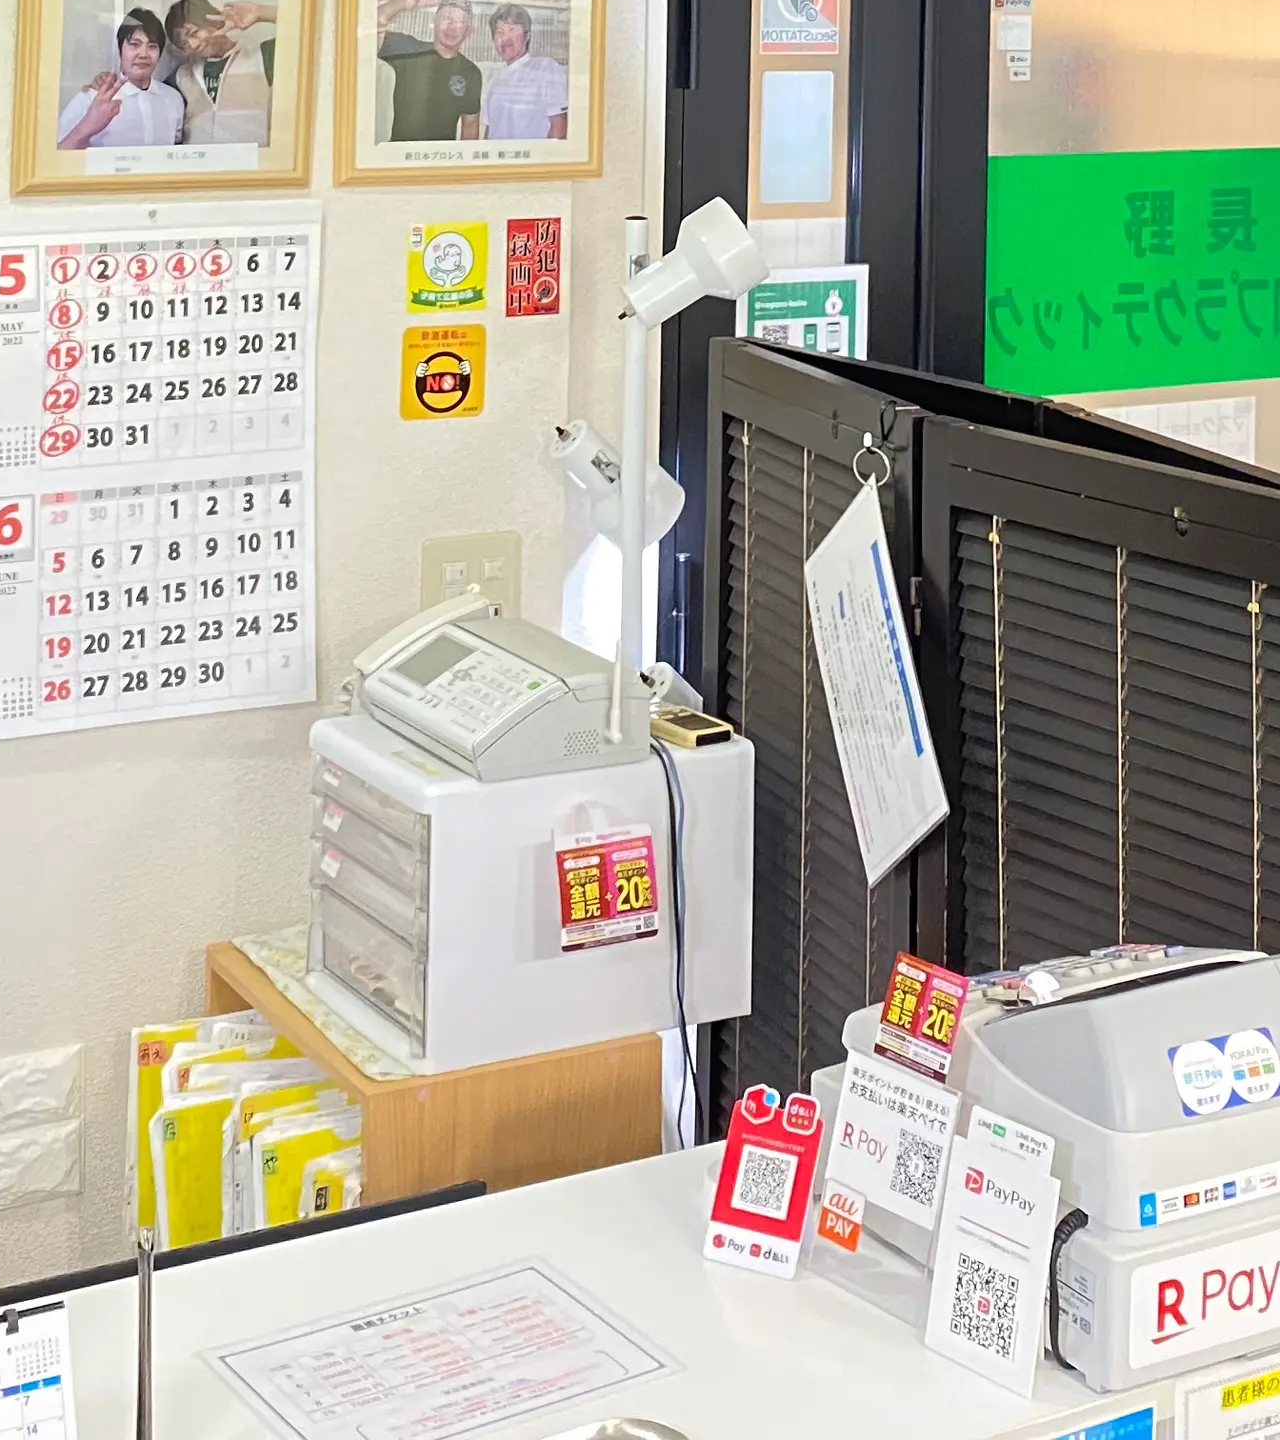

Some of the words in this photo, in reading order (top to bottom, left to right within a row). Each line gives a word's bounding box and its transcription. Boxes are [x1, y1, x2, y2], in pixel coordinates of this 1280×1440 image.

[405, 151, 463, 160] 新日本プロレス
[535, 221, 558, 273] 防犯
[97, 260, 109, 279] 2
[135, 258, 147, 277] 3
[172, 257, 185, 276] 4
[210, 255, 222, 276] 5
[247, 253, 259, 272] 6
[284, 252, 296, 271] 7
[510, 233, 531, 313] 録画中
[57, 305, 70, 324] 8
[97, 302, 109, 322] 9
[129, 300, 153, 319] 10
[167, 298, 189, 317] 11
[204, 296, 227, 315] 12
[241, 294, 263, 312] 13
[277, 291, 301, 311] 14
[0, 322, 24, 332] MAY
[91, 344, 115, 363] 16
[129, 342, 152, 361] 17
[167, 340, 190, 359] 18
[203, 337, 227, 356] 19
[239, 334, 263, 354] 20
[275, 332, 297, 351] 21
[48, 389, 75, 409] 22
[88, 386, 113, 405] 23
[126, 383, 152, 403] 24
[164, 381, 190, 400] 25
[202, 378, 226, 397] 26
[238, 375, 262, 394] 27
[274, 373, 298, 392] 28
[426, 374, 460, 391] NO!
[47, 432, 75, 451] 29
[87, 428, 113, 447] 30
[126, 425, 149, 445] 31
[171, 500, 179, 518] 1
[206, 496, 218, 515] 2
[244, 493, 254, 512] 3
[279, 489, 291, 508] 4
[53, 552, 65, 572] 5
[92, 549, 105, 568] 6
[130, 545, 142, 565] 7
[169, 541, 181, 561] 8
[206, 538, 218, 557] 9
[238, 533, 260, 553] 10
[274, 530, 296, 549] 11
[46, 595, 71, 616] 12
[86, 590, 109, 611] 13
[124, 586, 149, 607] 14
[162, 583, 186, 602] 15
[200, 579, 224, 599] 16
[237, 575, 260, 595] 17
[274, 571, 298, 590] 18
[46, 638, 71, 659] 19
[84, 633, 109, 654] 20
[122, 629, 146, 650] 21
[160, 625, 186, 645] 22
[199, 621, 223, 640] 23
[236, 616, 261, 636] 24
[273, 613, 298, 632] 25
[44, 680, 70, 702] 26
[84, 676, 108, 697] 27
[122, 671, 148, 692] 28
[161, 667, 186, 687] 29
[199, 662, 224, 683] 30
[849, 1081, 948, 1134] お支払いは楽天ペイで
[857, 1129, 888, 1164] Pay
[986, 1179, 1036, 1217] PayPay
[826, 1216, 854, 1239] PAY
[728, 1239, 745, 1254] Pay
[1202, 1260, 1280, 1321] Pay
[25, 1425, 38, 1436] 14
